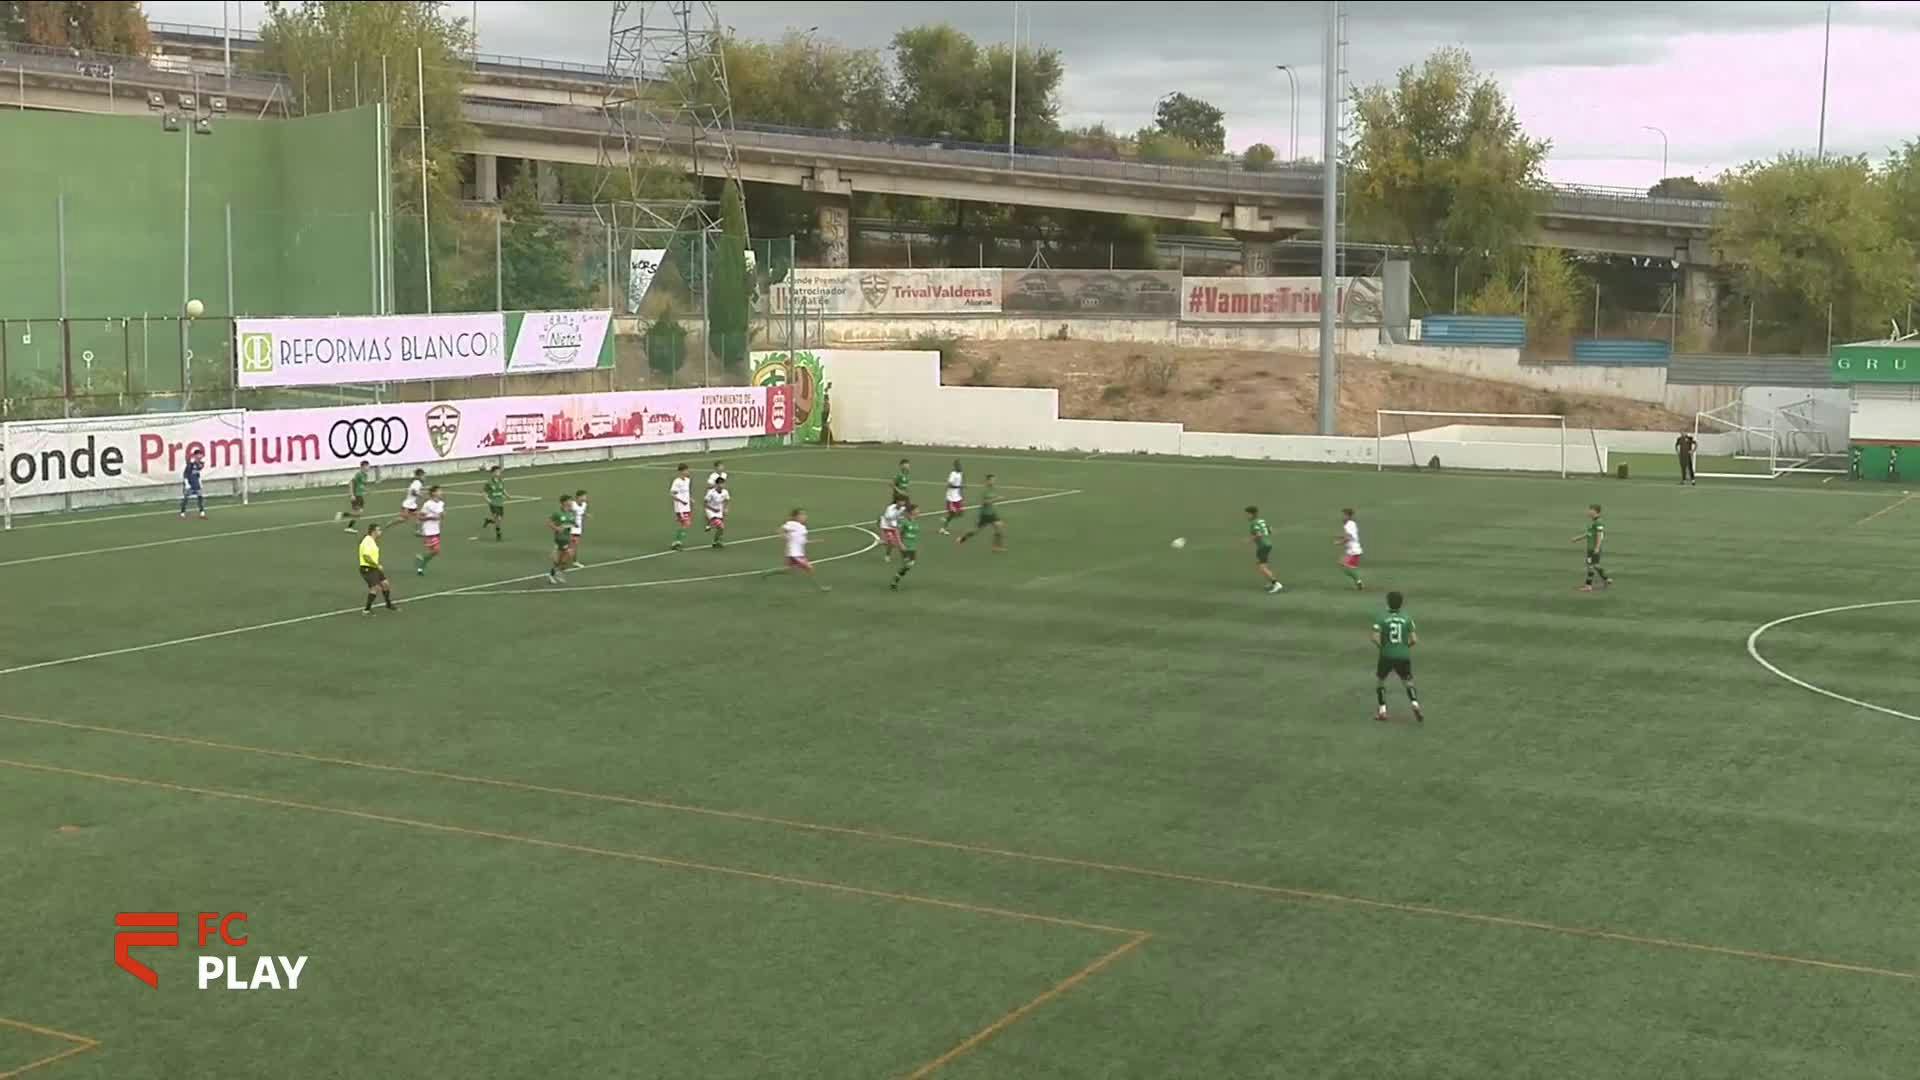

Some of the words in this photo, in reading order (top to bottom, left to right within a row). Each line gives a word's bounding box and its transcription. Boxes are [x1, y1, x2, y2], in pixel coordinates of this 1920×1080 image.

[1190, 287, 1344, 314] #VamosTrivl
[280, 337, 392, 365] REFORMAS
[0, 434, 124, 485] onde
[139, 427, 320, 474] Premium
[1389, 622, 1402, 643] 21
